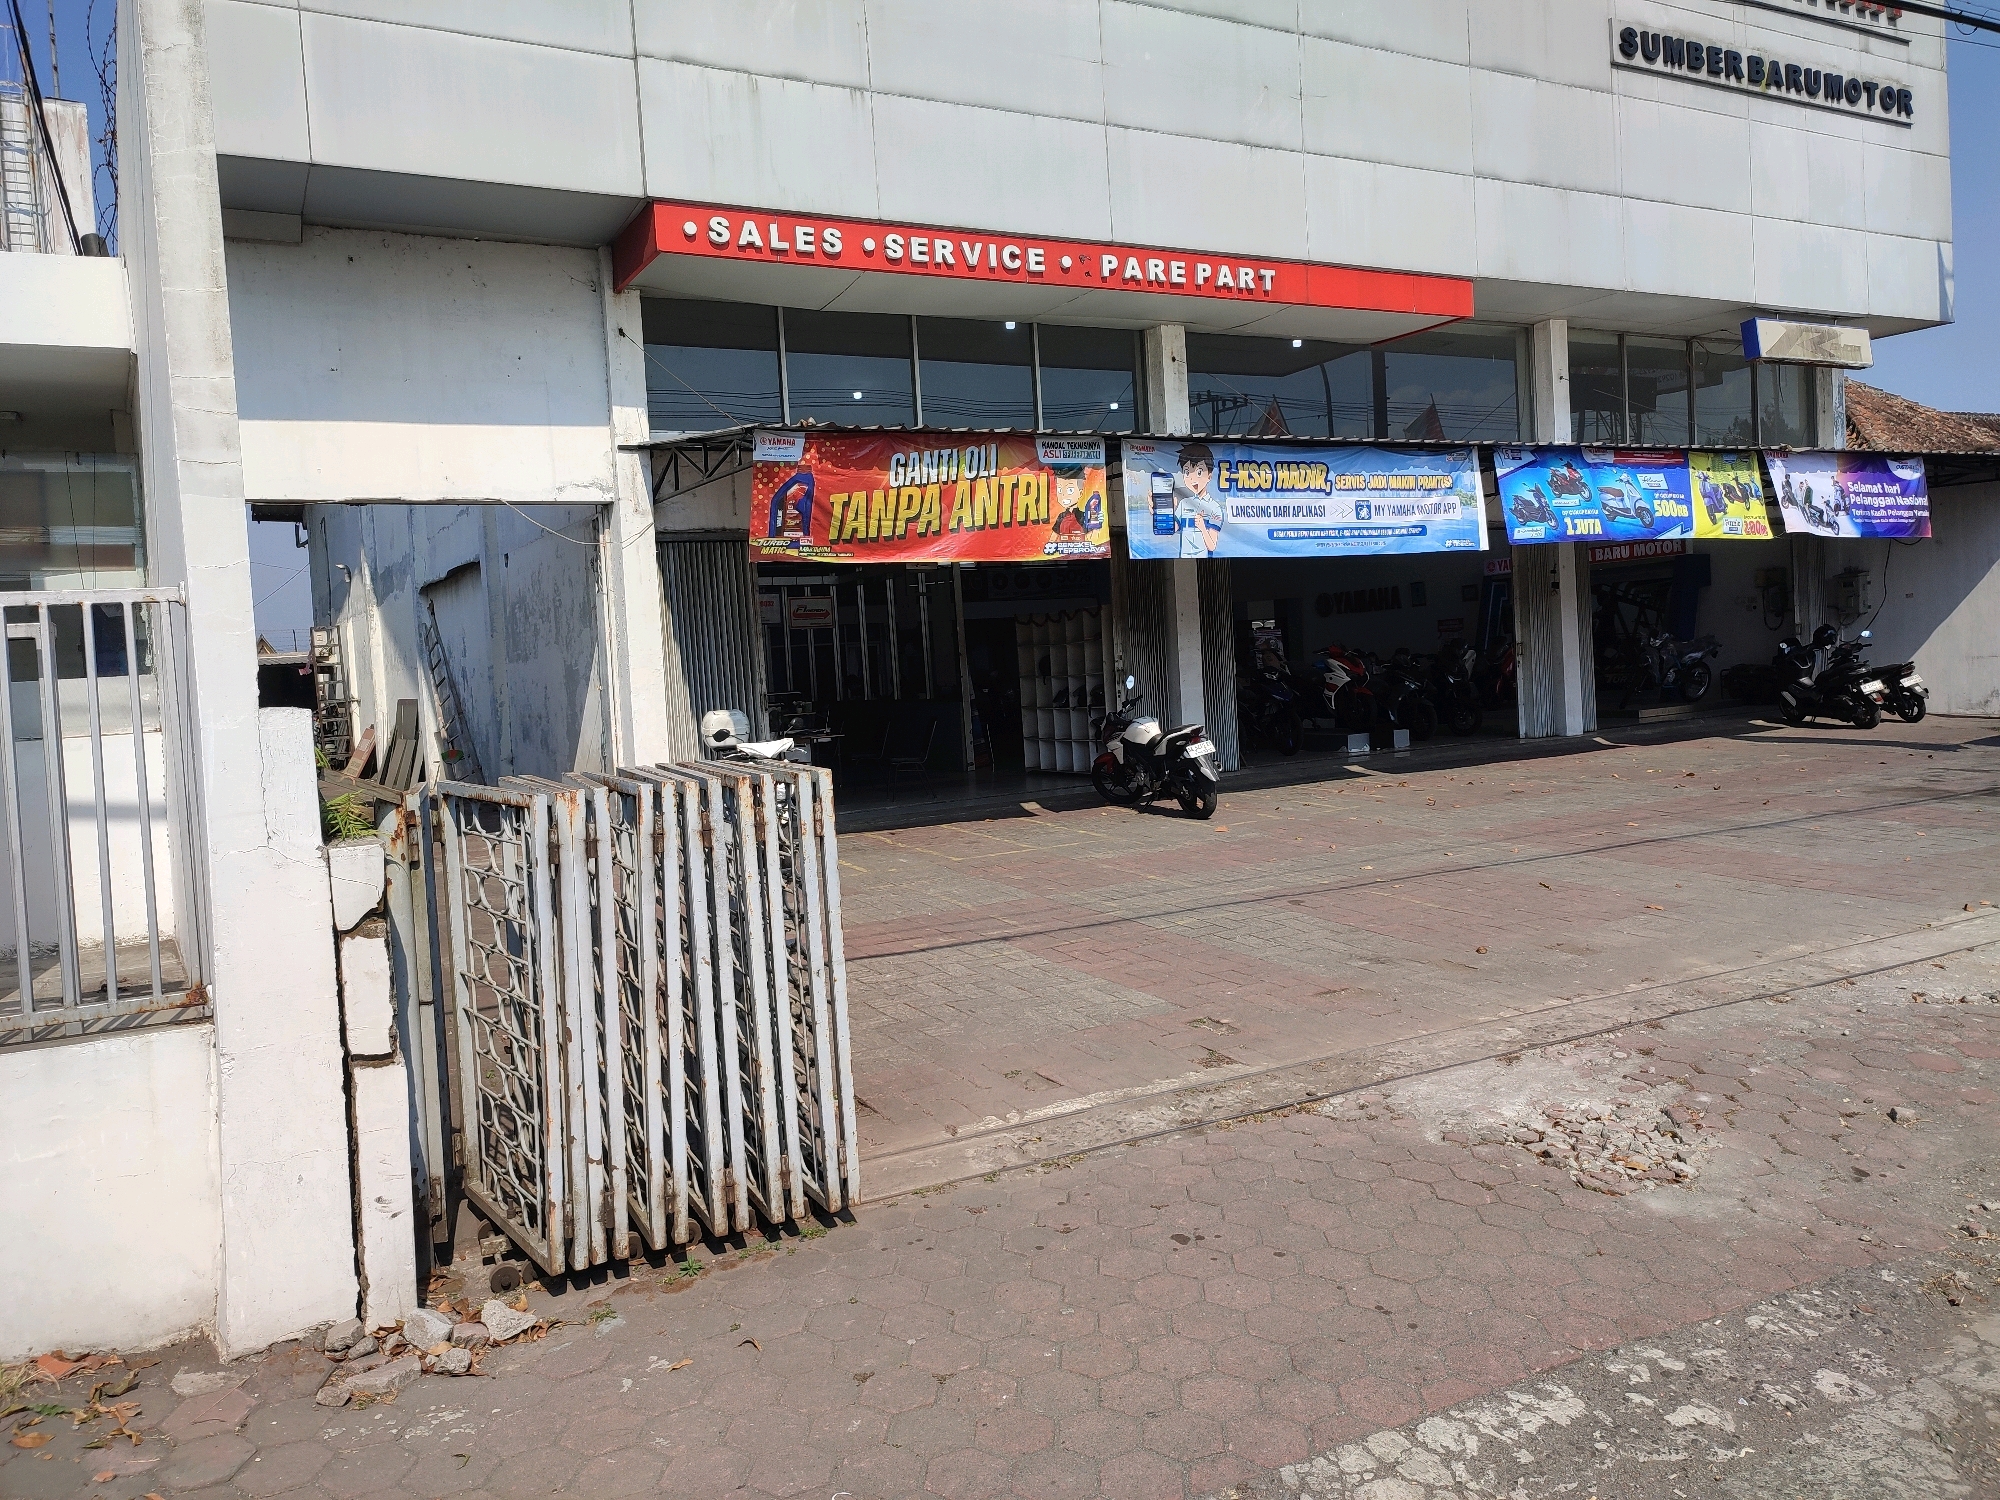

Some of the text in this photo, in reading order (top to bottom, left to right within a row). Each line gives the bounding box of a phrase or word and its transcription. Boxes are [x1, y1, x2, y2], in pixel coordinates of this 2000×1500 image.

[1619, 26, 1914, 118] SUMBER BARU MOTOR
[707, 216, 1276, 292] SALES SERVICE PARE PART
[767, 437, 796, 446] YAMAHA
[1042, 450, 1062, 459] ASLI
[889, 443, 998, 488] GANTI OLI
[1276, 463, 1331, 492] HADIR,
[1334, 474, 1366, 490] SERVIS
[1367, 474, 1387, 490] JADI
[1848, 481, 1900, 495] Selamat hari
[829, 483, 941, 543] TANPA
[948, 472, 1050, 534] ANTRI
[1849, 494, 1929, 508] Pelanggan Nasional
[1230, 504, 1326, 518] LANGSUNG DARI APLIKASI
[1374, 504, 1385, 516] MY
[1386, 503, 1416, 517] YAMAHA
[1417, 503, 1442, 515] MOTOR
[1443, 502, 1457, 514] APP
[1852, 508, 1871, 517] Terima
[1871, 508, 1888, 517] Kasih
[1887, 509, 1914, 518] Pelanggan
[1563, 516, 1574, 536] 1
[1574, 518, 1603, 535] JUTA
[760, 546, 787, 555] MATIC
[1595, 539, 1683, 561] BARU MOTOR
[1333, 585, 1402, 615] YAMAHA
